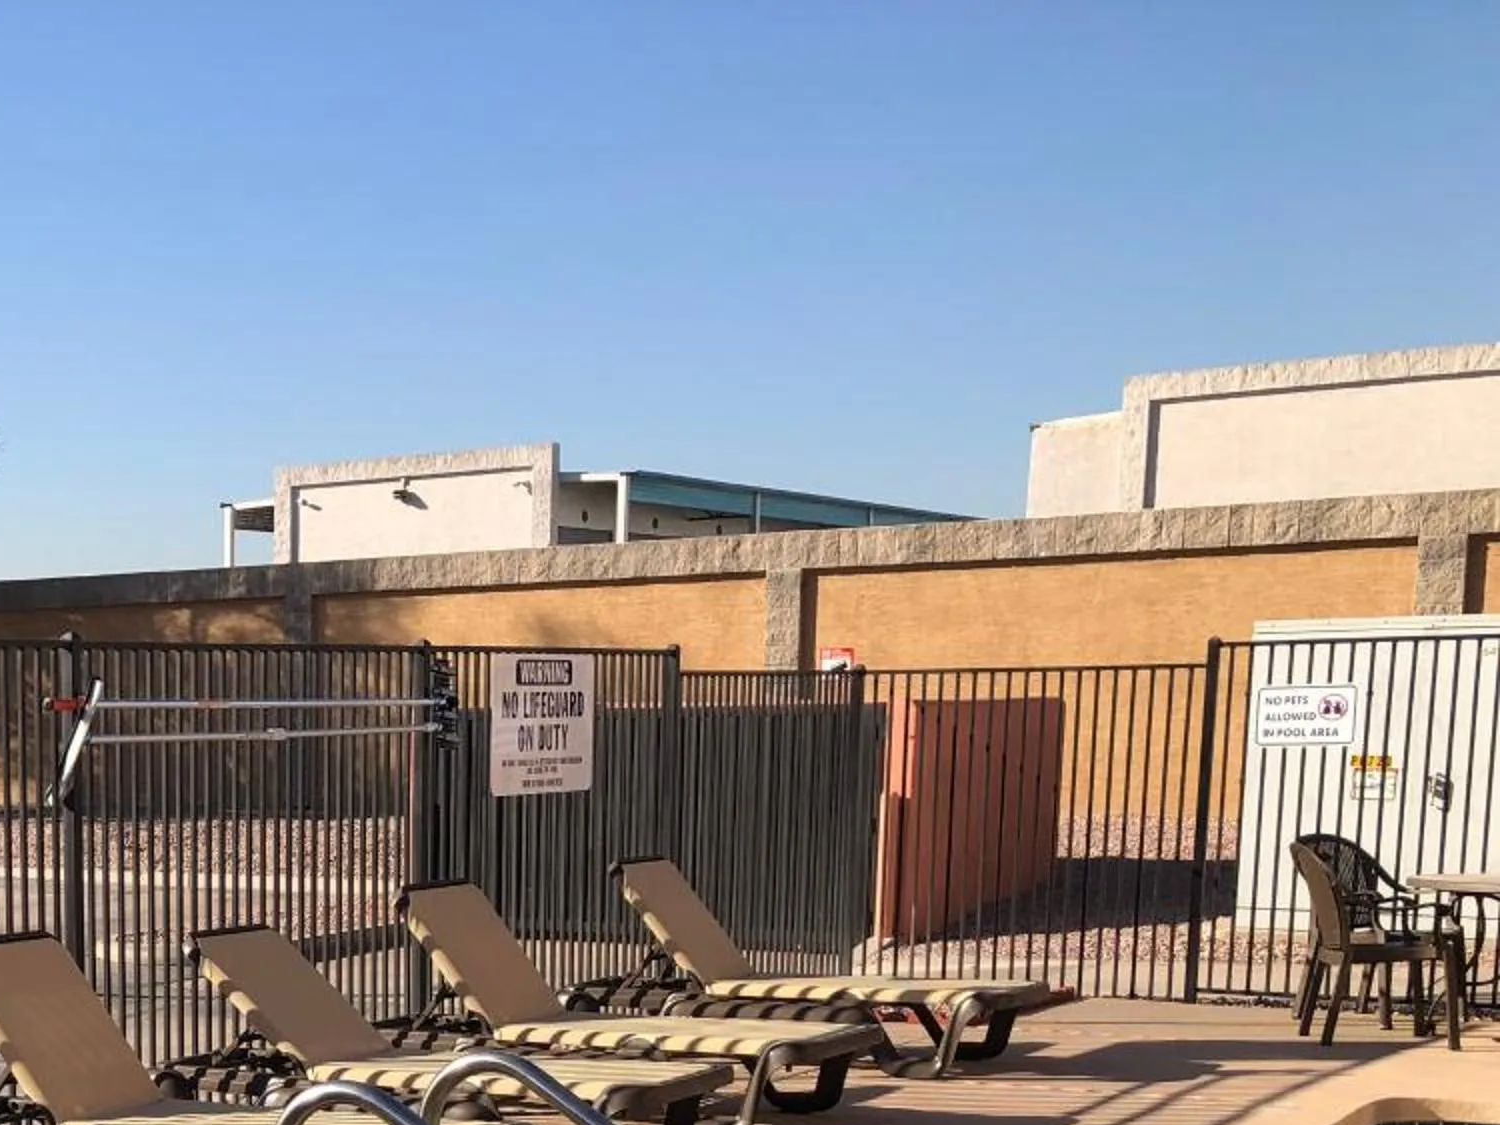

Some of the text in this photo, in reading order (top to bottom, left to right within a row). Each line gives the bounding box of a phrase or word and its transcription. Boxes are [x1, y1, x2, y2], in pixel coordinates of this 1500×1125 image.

[519, 661, 569, 683] WARNING
[501, 691, 584, 718] NO LIFEGUARD
[1265, 695, 1309, 705] NO PETS
[1265, 711, 1317, 721] ALLOWED
[517, 724, 569, 752] ON DUTY
[1263, 727, 1339, 737] IN POOL AREA
